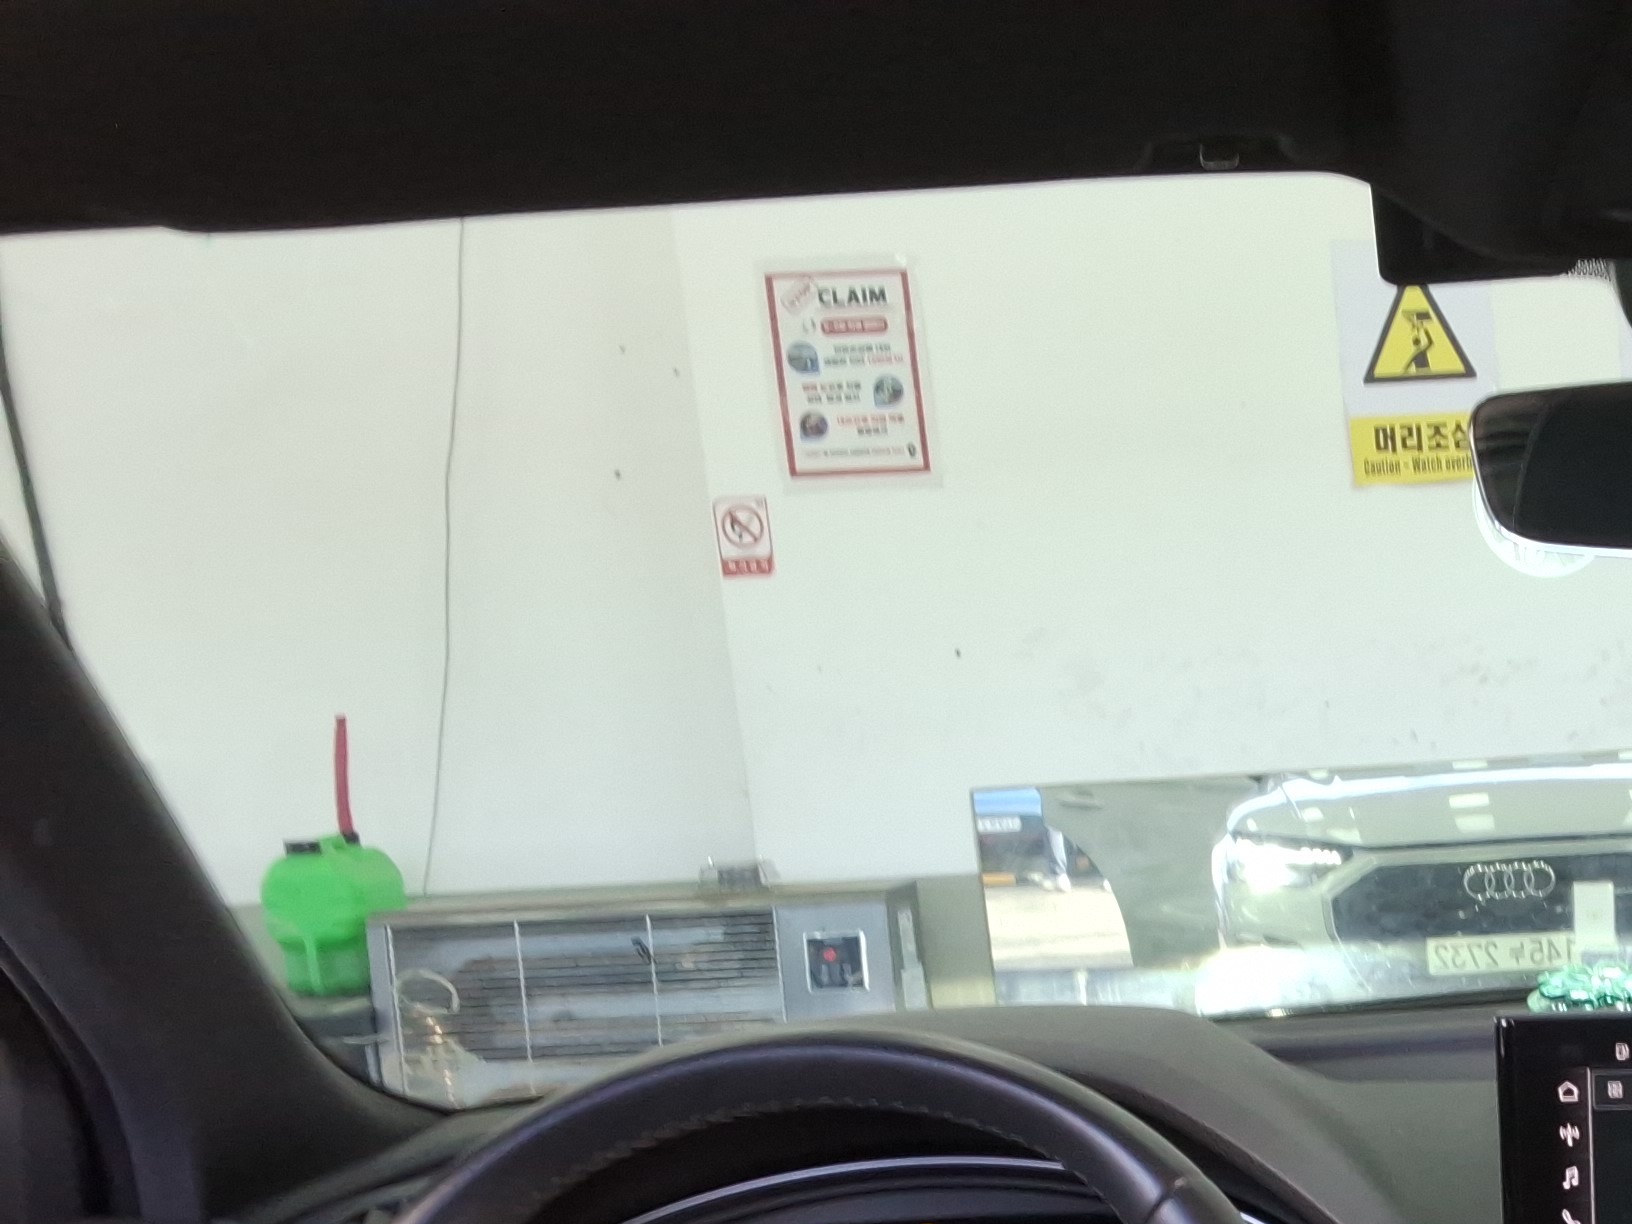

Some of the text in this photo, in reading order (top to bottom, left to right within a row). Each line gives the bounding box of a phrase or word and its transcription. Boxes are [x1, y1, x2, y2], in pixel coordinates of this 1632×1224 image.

[818, 285, 888, 306] CLAIM
[1364, 457, 1401, 476] Caution
[1412, 455, 1443, 475] Watch
